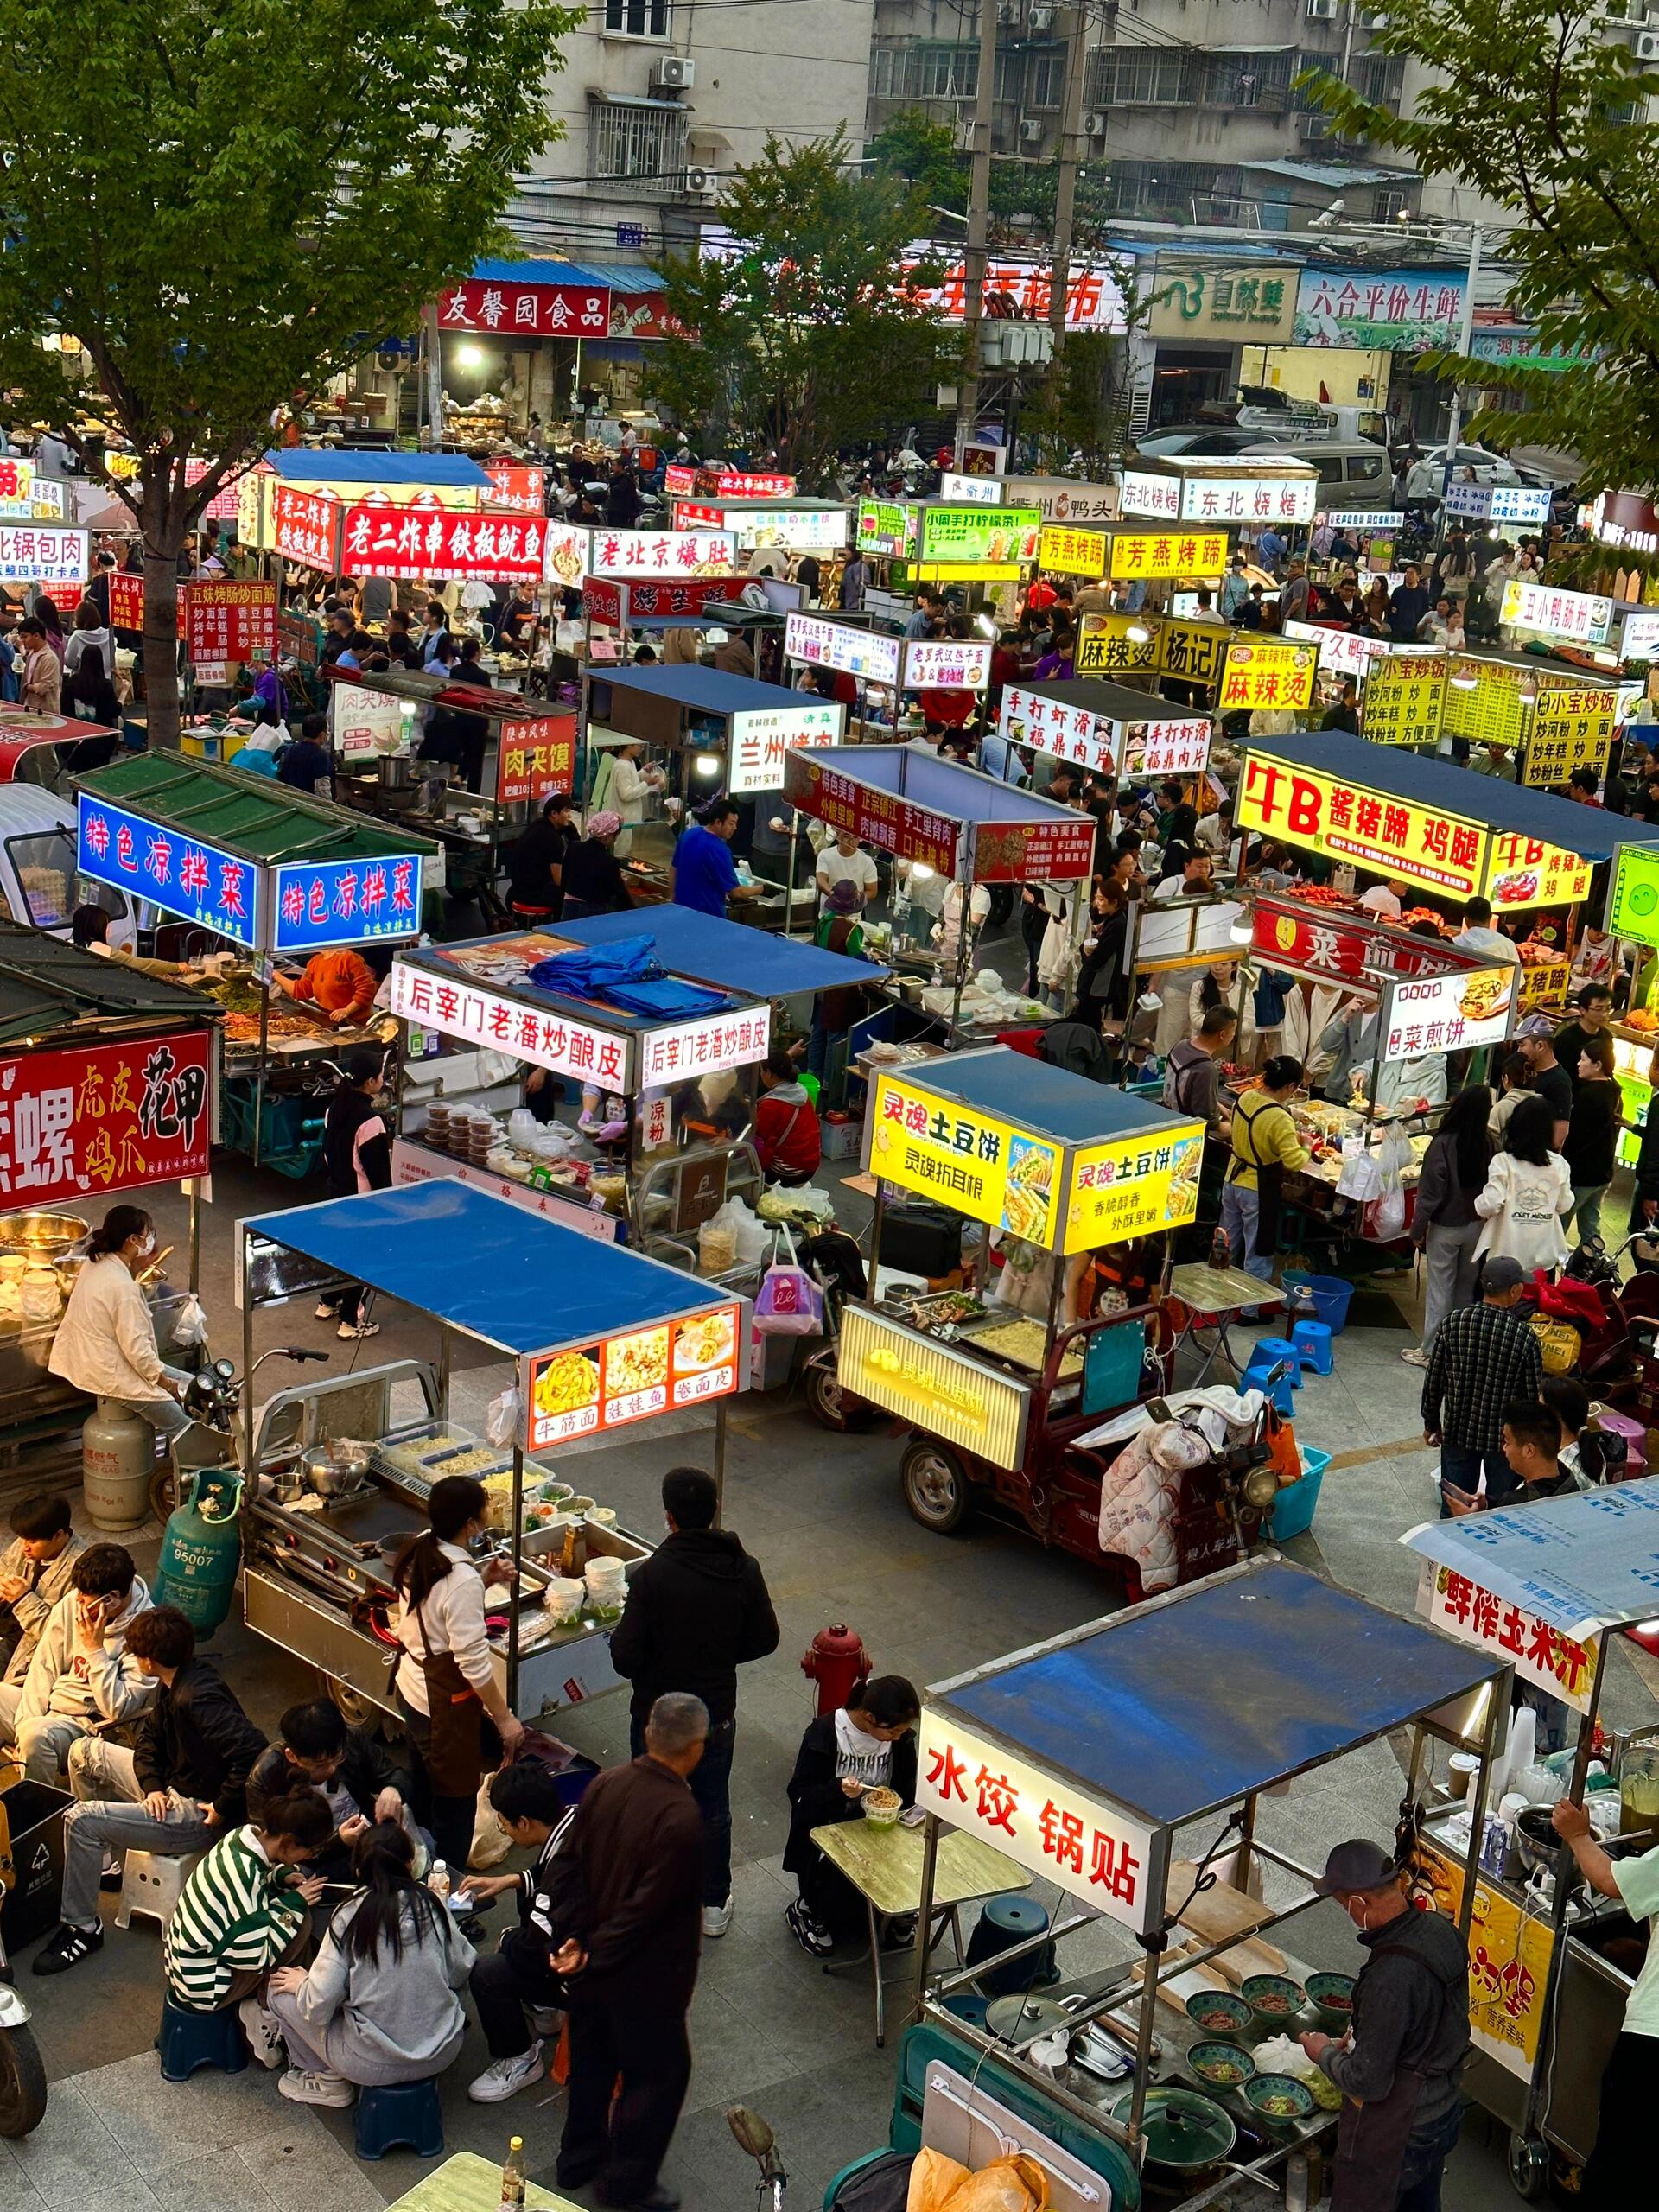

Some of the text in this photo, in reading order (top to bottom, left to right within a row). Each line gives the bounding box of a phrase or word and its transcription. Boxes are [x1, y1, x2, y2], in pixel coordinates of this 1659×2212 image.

[443, 288, 605, 329] 友馨园食品
[1310, 279, 1461, 324] 六合平价生鲜
[281, 493, 331, 531] 老二炸串
[1071, 499, 1112, 518] 鸭头
[1124, 481, 1178, 512] 东北烧烤
[1201, 483, 1297, 516] 东北烧烤
[279, 521, 331, 561] 铁板鱿鱼
[598, 537, 729, 568] 老北京爆肚
[1049, 532, 1102, 564] 芳燕烤蹄
[1128, 537, 1222, 568] 芳燕烤蹄
[111, 576, 143, 594] 五妹烤
[191, 585, 276, 604] 五妹烤肠炒面筋
[194, 607, 274, 620] 炒面筋 香豆腐
[238, 621, 274, 633] 臭豆腐
[238, 636, 275, 649] 炒土豆
[913, 648, 984, 664] 老罗武汉热干面
[1081, 635, 1157, 667] 麻辣烫
[1167, 629, 1219, 679] 杨记
[1255, 648, 1291, 664] 麻辣拌
[1384, 658, 1446, 680] 小宝炒饭
[1224, 669, 1306, 706] 麻辣烫
[1369, 685, 1402, 702] 炒河粉
[1551, 690, 1614, 715] 小宝炒饭
[1007, 691, 1090, 737] 手打虾滑
[1366, 706, 1400, 723] 炒年糕
[1536, 719, 1570, 739] 炒河粉
[506, 721, 550, 741] 陕西风味
[1149, 720, 1209, 744] 手打虾滑
[1363, 725, 1436, 743] 炒粉丝 方便面
[505, 742, 570, 779] 肉夹馍
[1029, 725, 1113, 770] 福鼎肉片
[1147, 747, 1205, 771] 福鼎肉片
[1533, 741, 1567, 760] 炒年糕
[1529, 763, 1564, 782] 炒粉丝
[822, 771, 951, 846] 特色美食 正宗镇江 手工里脊肉
[1245, 761, 1481, 871] 牛B 酱猪蹄 鸡腿
[86, 813, 248, 919] 特色凉拌菜
[283, 860, 415, 927] 特色凉拌菜
[1544, 876, 1586, 897] 鸡腿
[195, 907, 244, 939] 自选凉拌菜
[364, 918, 413, 936] 自选凉拌菜
[410, 977, 623, 1082] 后宰门老潘炒酿皮
[1403, 1018, 1465, 1052] 菜煎饼
[652, 1020, 767, 1073] 后宰门老潘炒酿皮
[76, 1061, 137, 1124] 虎皮
[138, 1045, 207, 1153] 花甲
[649, 1099, 666, 1142] 凉粉
[883, 1090, 1001, 1166] 灵魂土豆饼
[0, 1086, 75, 1192] 螺
[86, 1124, 147, 1185] 鸡爪
[904, 1147, 985, 1202] 灵魂折耳根
[1077, 1146, 1171, 1191] 灵魂土豆饼
[1093, 1192, 1141, 1217] 香脆醇香
[1110, 1206, 1158, 1231] 外酥里嫩
[676, 1370, 730, 1400] 卷面皮
[607, 1389, 665, 1421] 娃娃鱼
[537, 1408, 596, 1440] 牛筋面
[175, 1549, 214, 1567] 95007
[1445, 1569, 1587, 1690] 鲜榨玉米汁
[925, 1744, 1140, 1906] 水饺 锅贴
[1487, 2008, 1526, 2048] 营养美味
